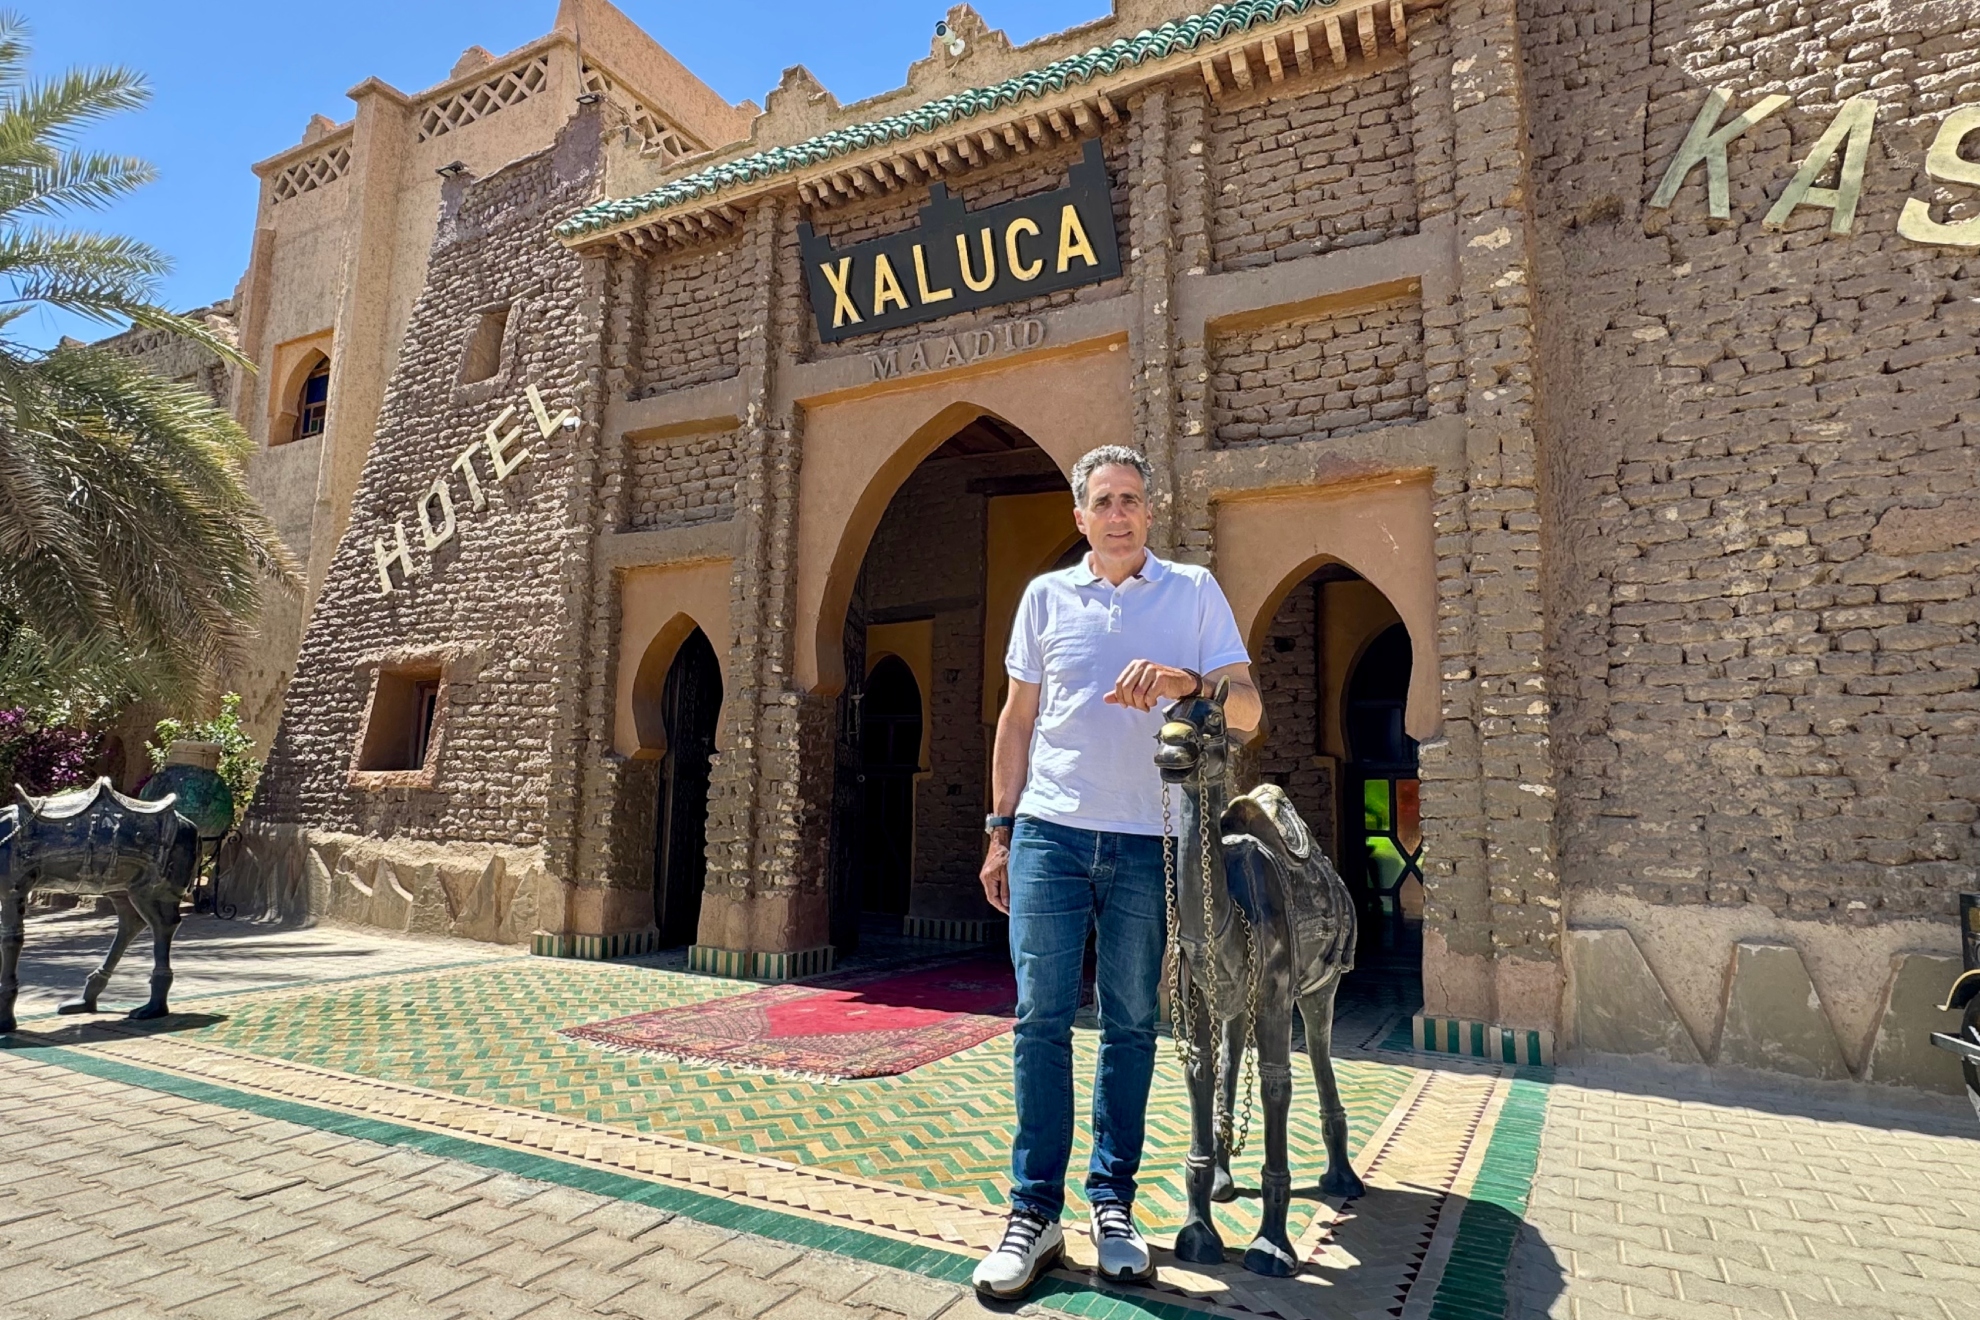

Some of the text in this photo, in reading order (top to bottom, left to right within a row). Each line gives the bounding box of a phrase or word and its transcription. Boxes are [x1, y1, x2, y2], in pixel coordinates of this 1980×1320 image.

[819, 204, 1099, 329] XALUCA
[869, 319, 1046, 380] MAADID
[374, 383, 576, 595] HOTEL
